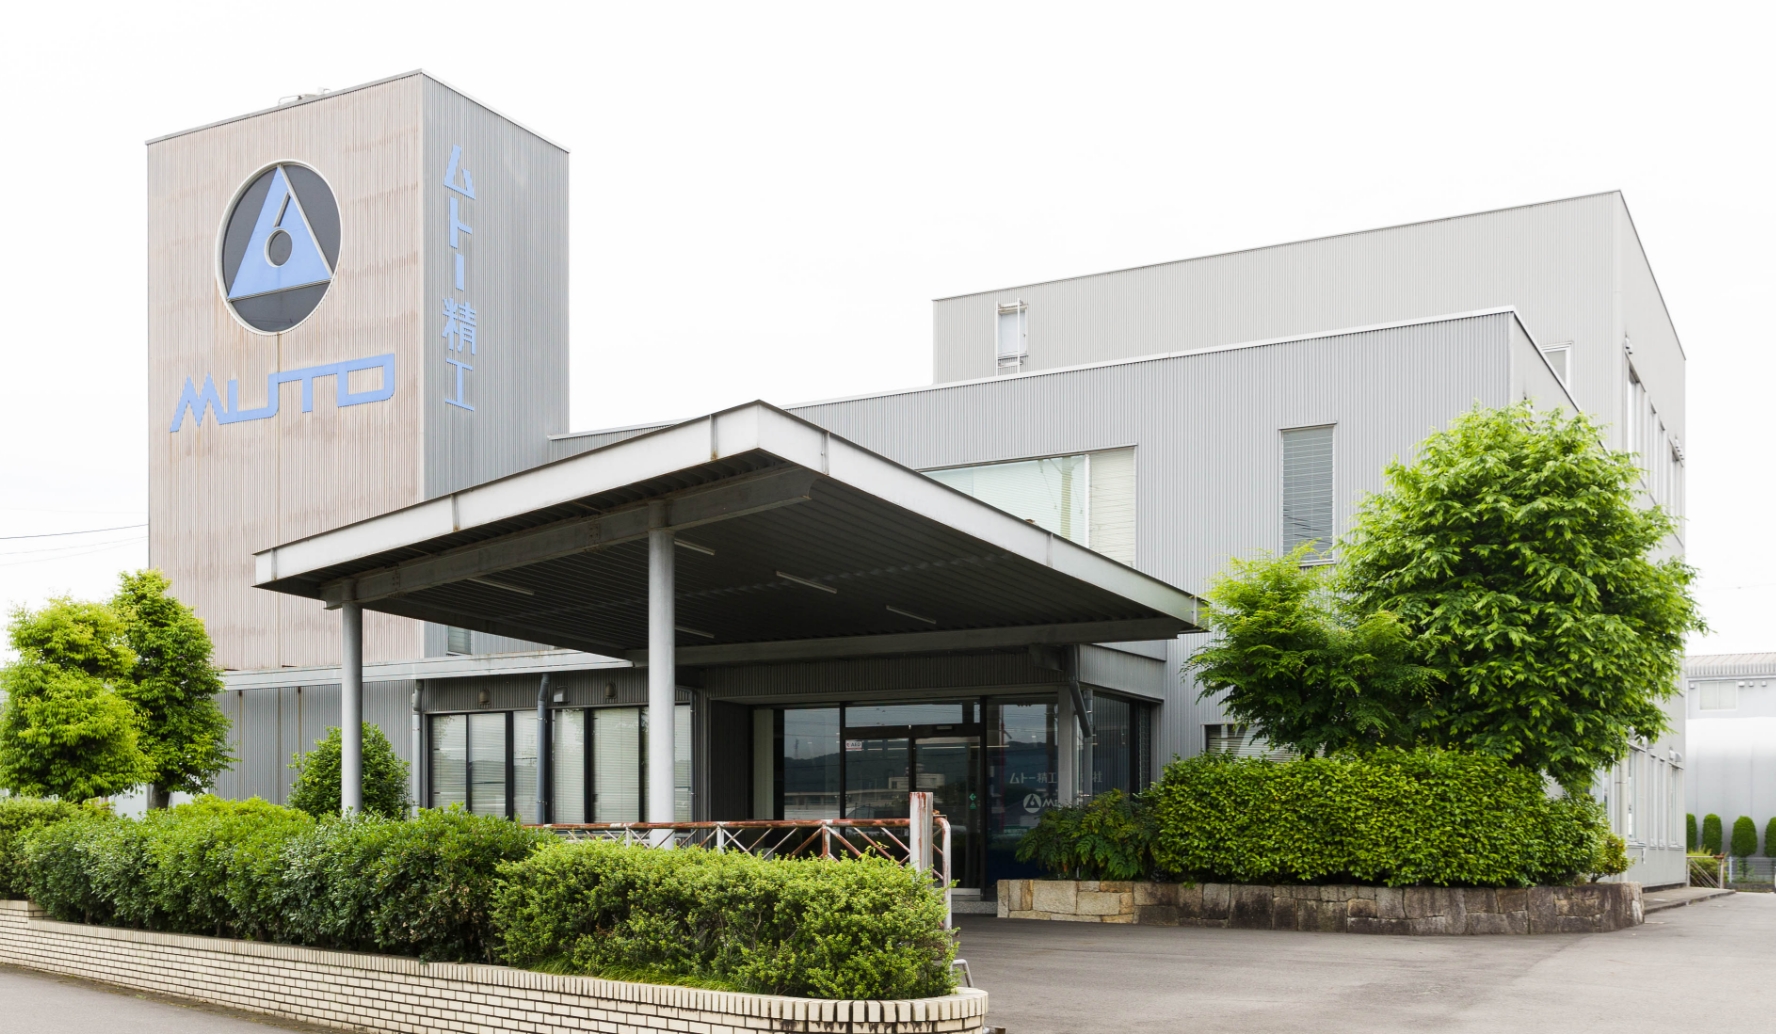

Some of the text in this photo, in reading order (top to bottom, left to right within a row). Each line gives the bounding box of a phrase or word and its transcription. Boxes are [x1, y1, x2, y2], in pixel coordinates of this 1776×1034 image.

[442, 145, 476, 411] ムトー精工
[170, 353, 395, 432] MUTO
